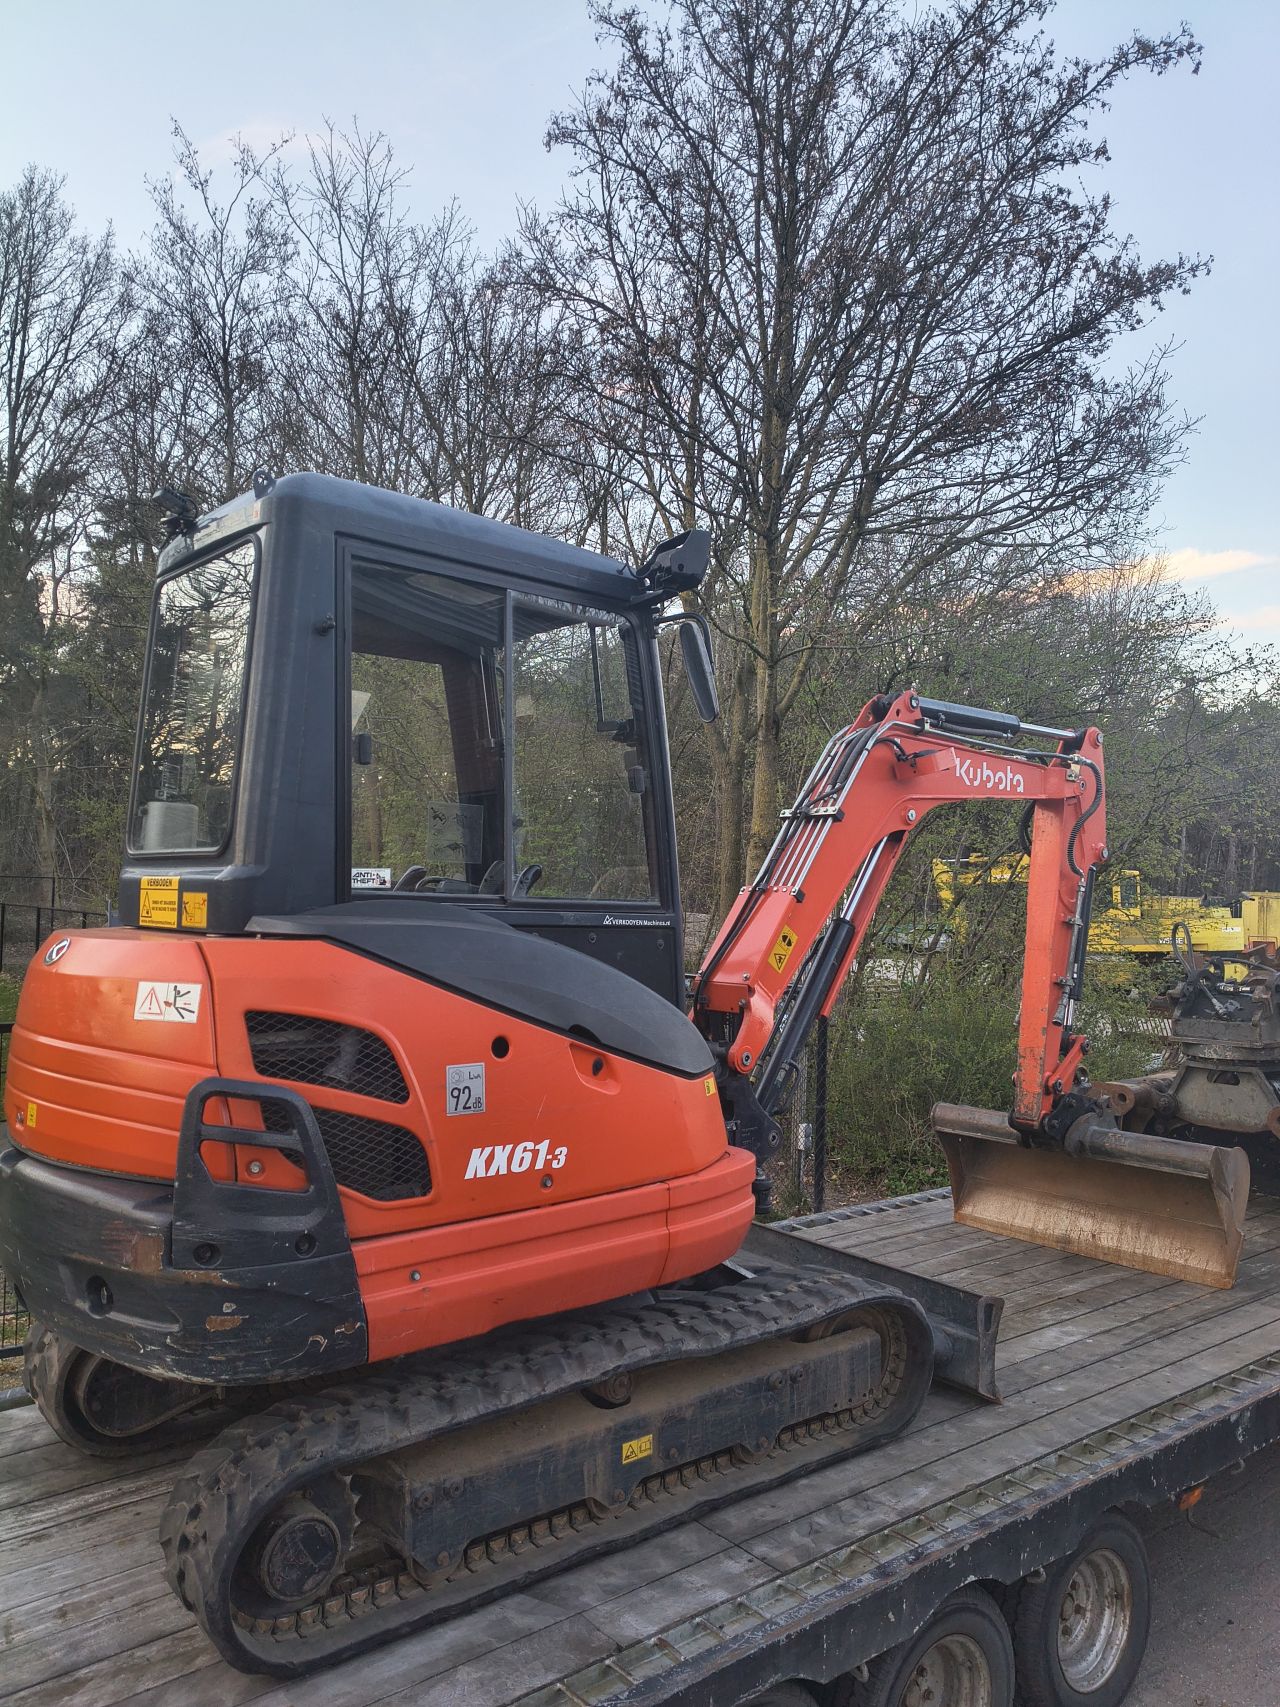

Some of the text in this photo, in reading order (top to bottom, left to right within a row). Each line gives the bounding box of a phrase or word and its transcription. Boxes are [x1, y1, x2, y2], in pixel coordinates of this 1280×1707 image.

[956, 757, 1024, 792] Kubota
[451, 1086, 482, 1111] 92 dB
[464, 1139, 568, 1179] KX61-3
